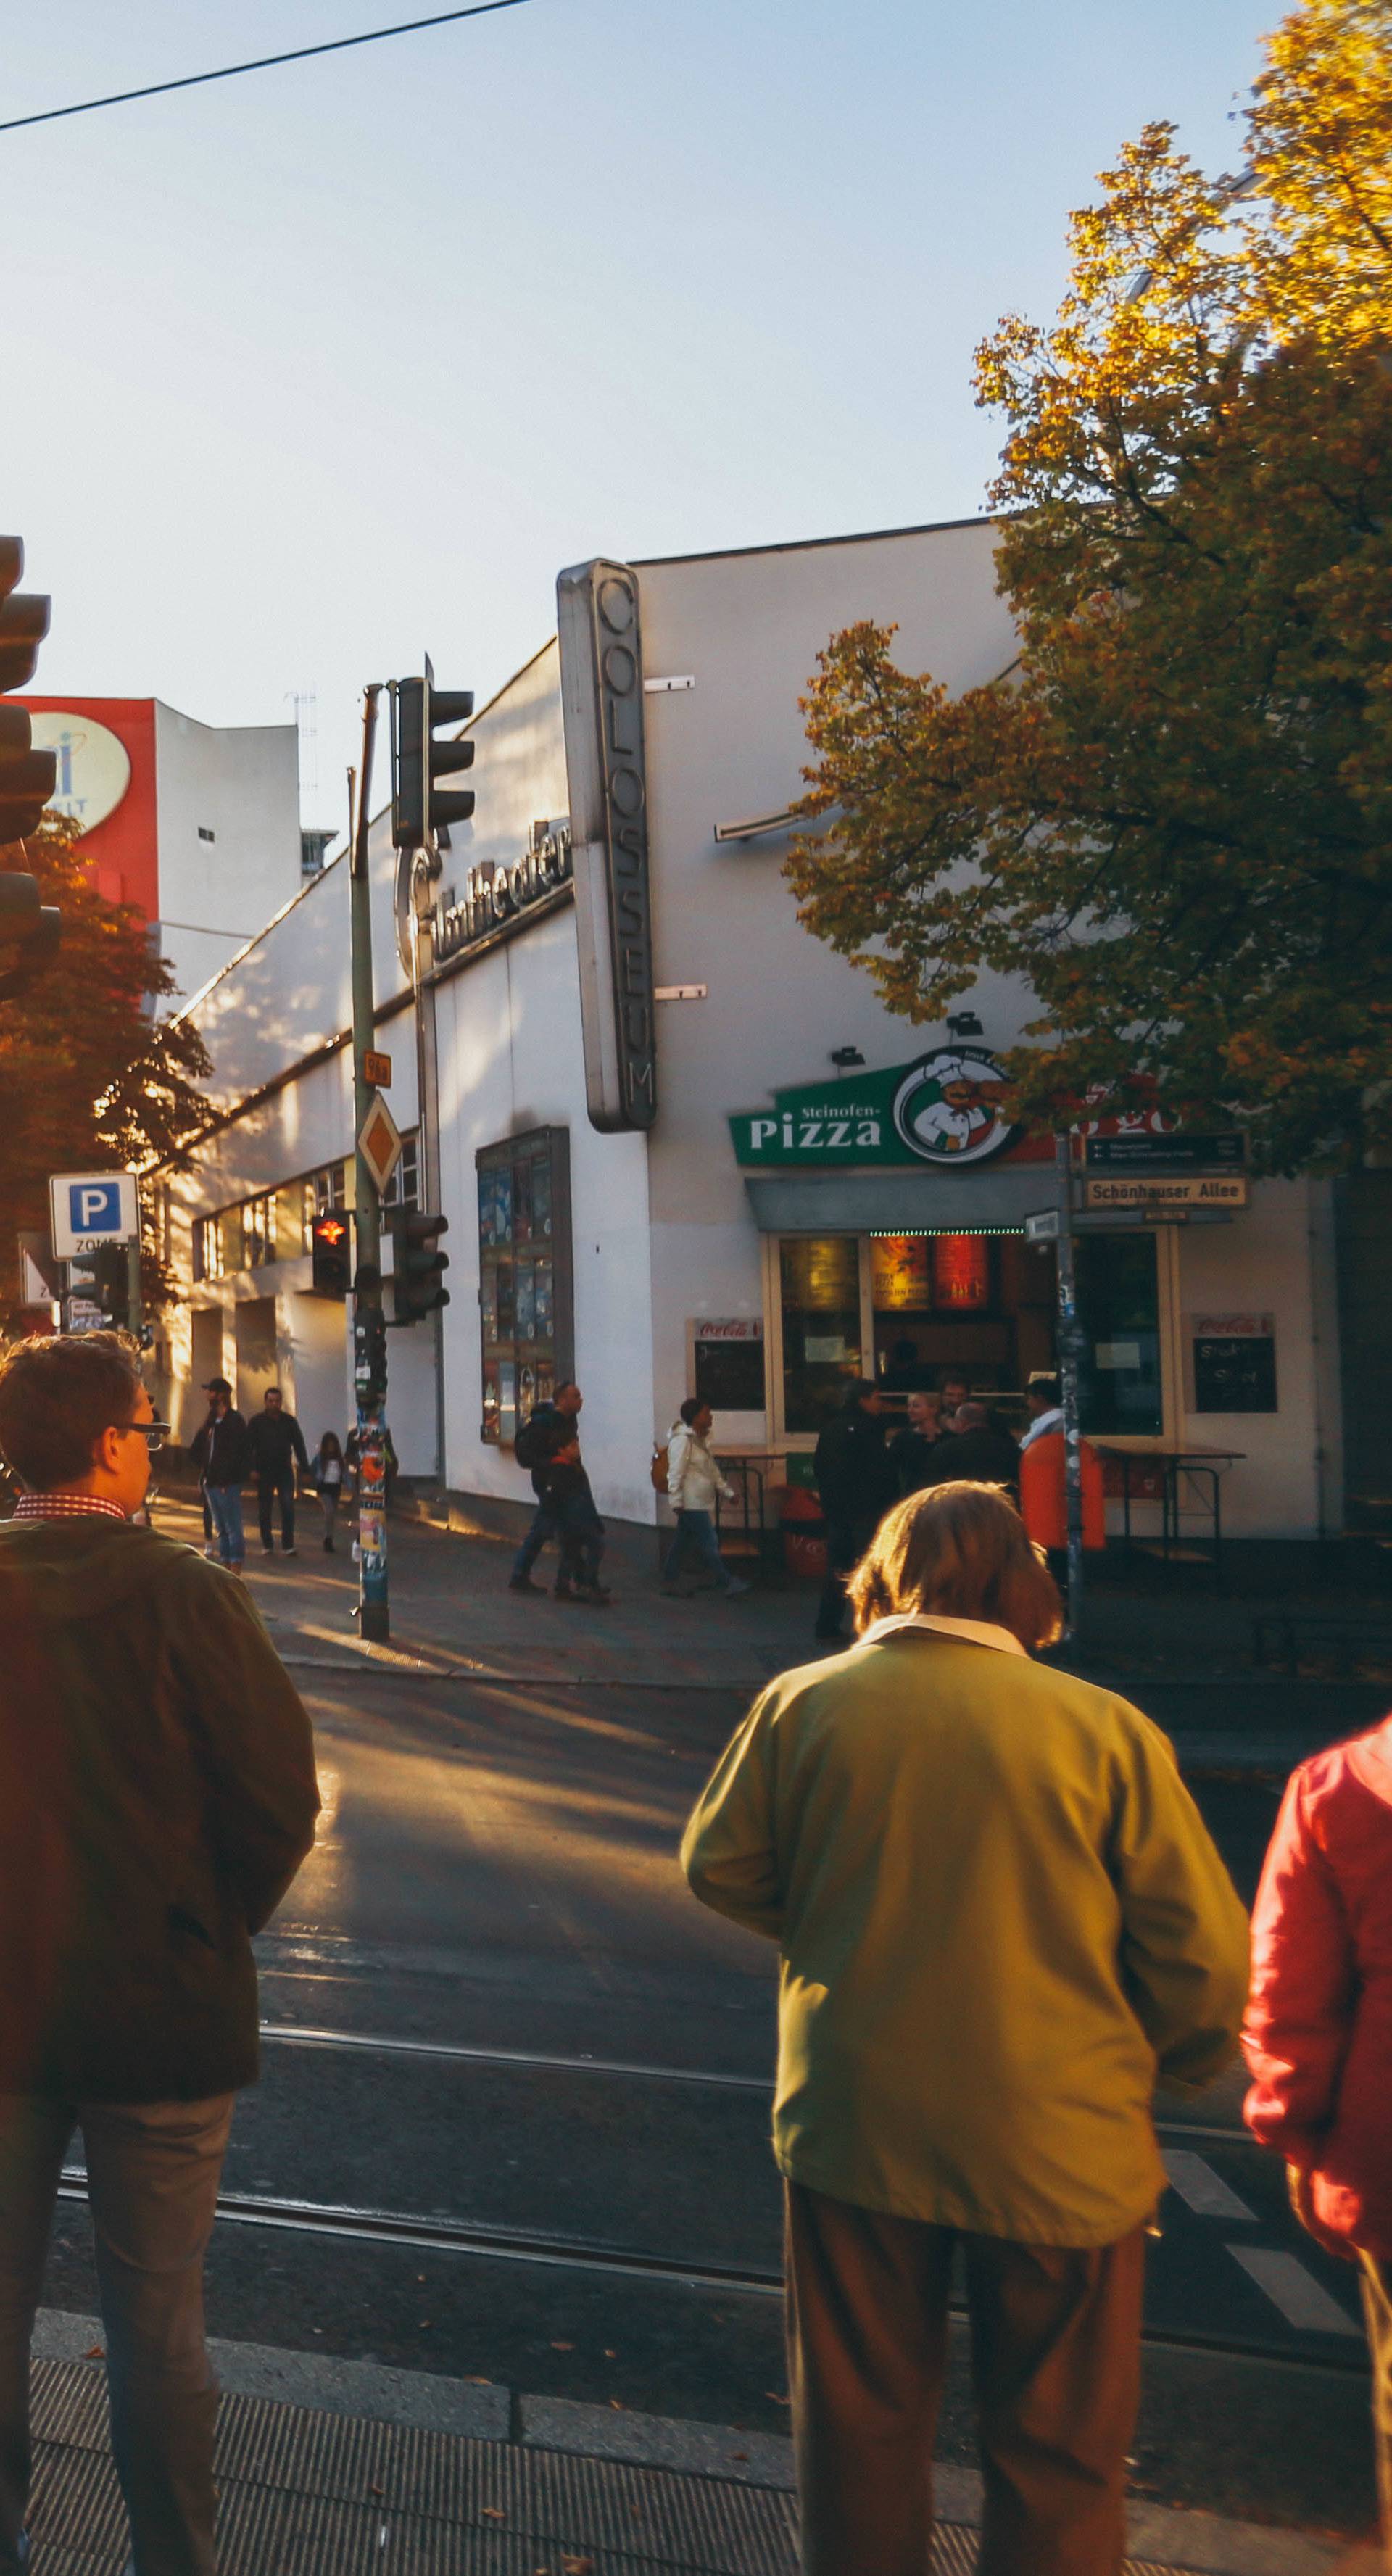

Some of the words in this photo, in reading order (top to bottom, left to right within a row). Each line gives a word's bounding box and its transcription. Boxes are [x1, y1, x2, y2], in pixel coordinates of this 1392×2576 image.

[597, 579, 652, 1103] COLOSSEUM
[750, 1113, 881, 1149] Pizza
[1093, 1183, 1190, 1199] Schönhauser
[1200, 1183, 1238, 1197] Allee
